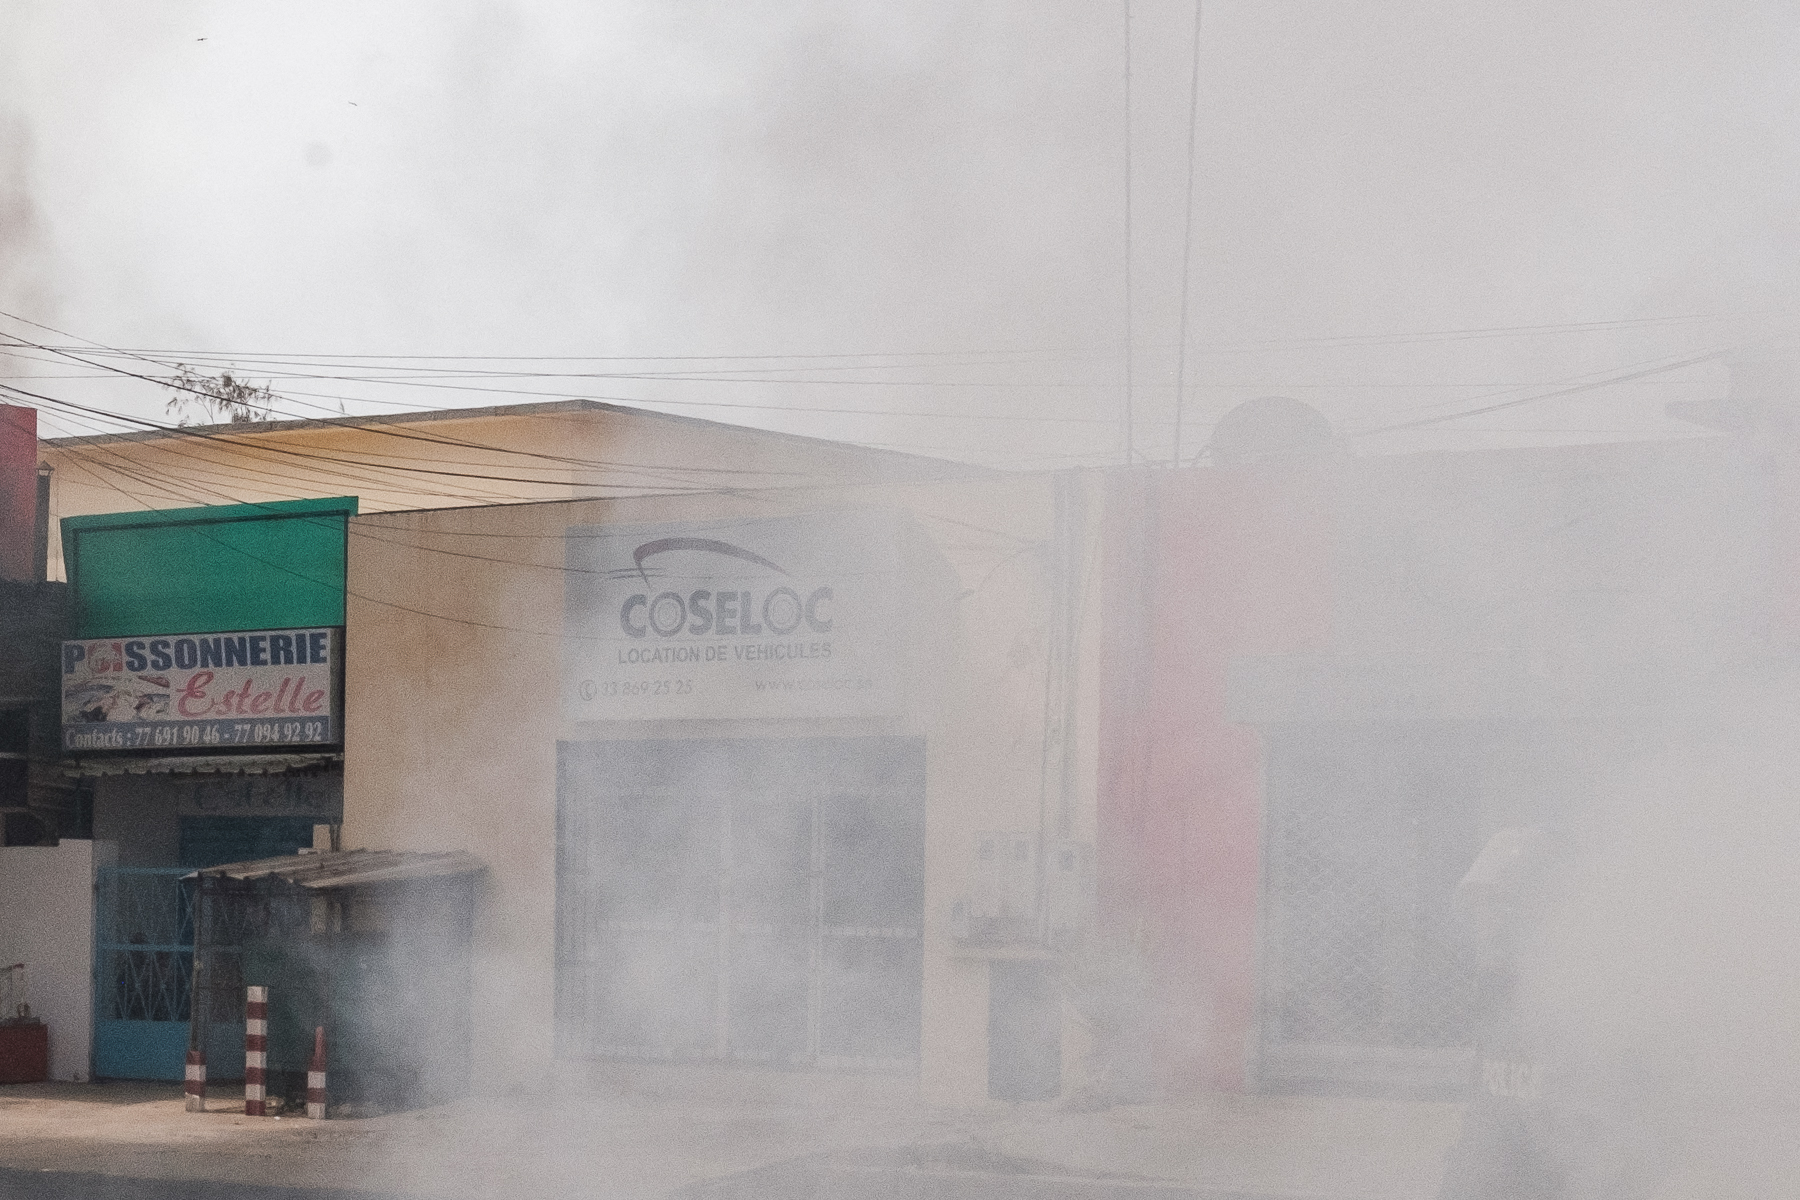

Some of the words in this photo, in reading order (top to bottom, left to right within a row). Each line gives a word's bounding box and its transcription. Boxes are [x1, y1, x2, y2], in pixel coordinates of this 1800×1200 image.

[620, 586, 834, 639] COSELOC
[618, 645, 700, 665] LOCATION
[705, 645, 728, 662] DE
[734, 642, 832, 661] VEHICULES
[176, 670, 326, 717] Estelle
[135, 727, 150, 746] 77
[203, 724, 220, 744] 46
[234, 724, 250, 743] 77
[284, 722, 301, 742] 92
[304, 721, 322, 741] 92
